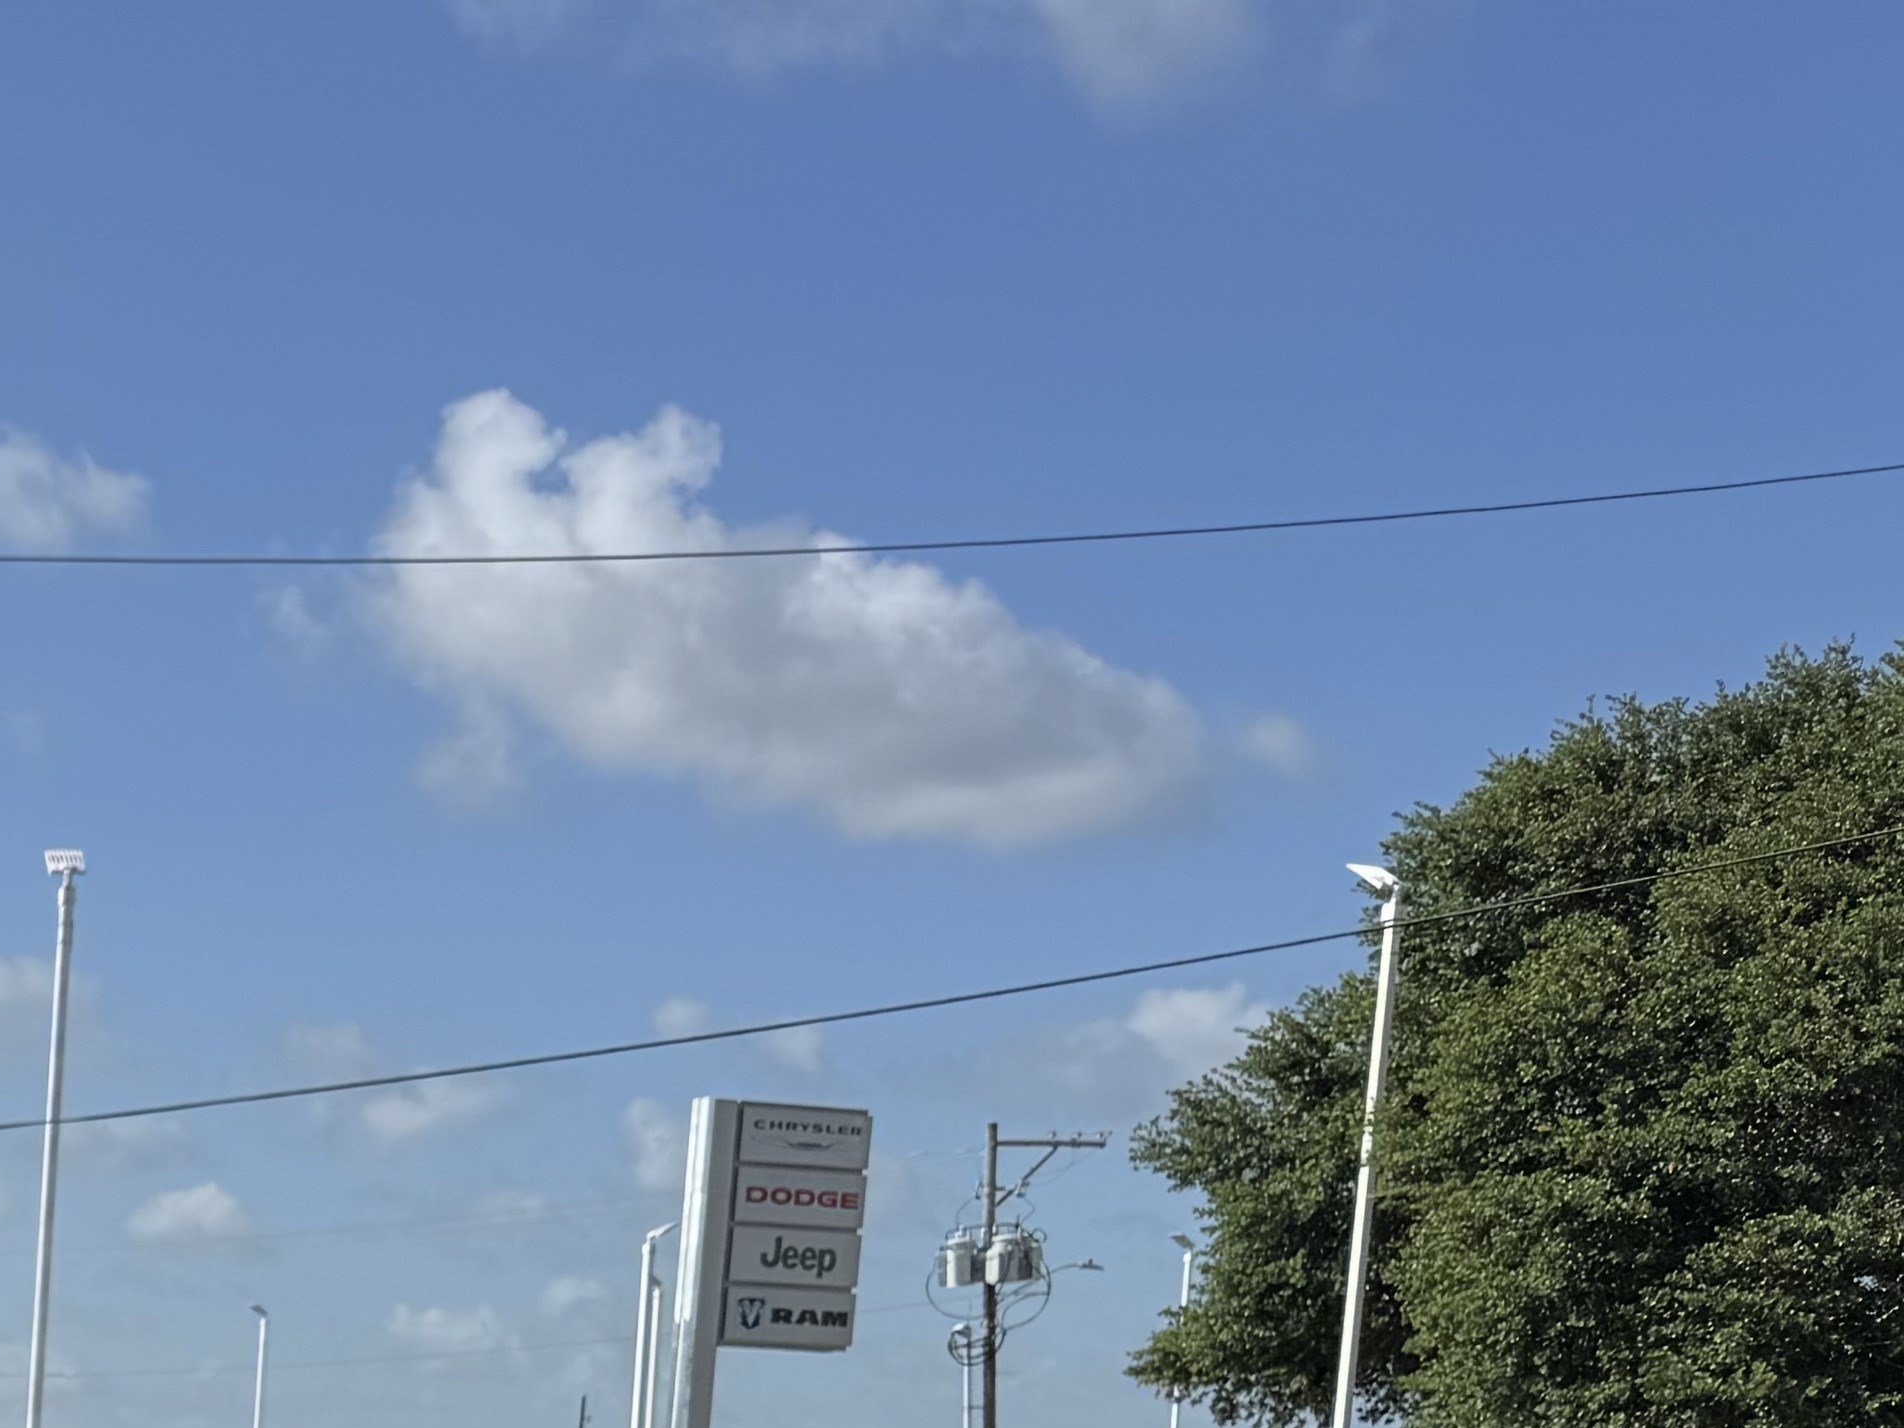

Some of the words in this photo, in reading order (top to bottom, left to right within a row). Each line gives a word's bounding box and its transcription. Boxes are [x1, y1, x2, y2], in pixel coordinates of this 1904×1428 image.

[753, 1118, 863, 1137] CHRYSLER
[745, 1186, 860, 1210] DODGE
[760, 1236, 837, 1279] Jeep
[770, 1307, 849, 1328] RAM
